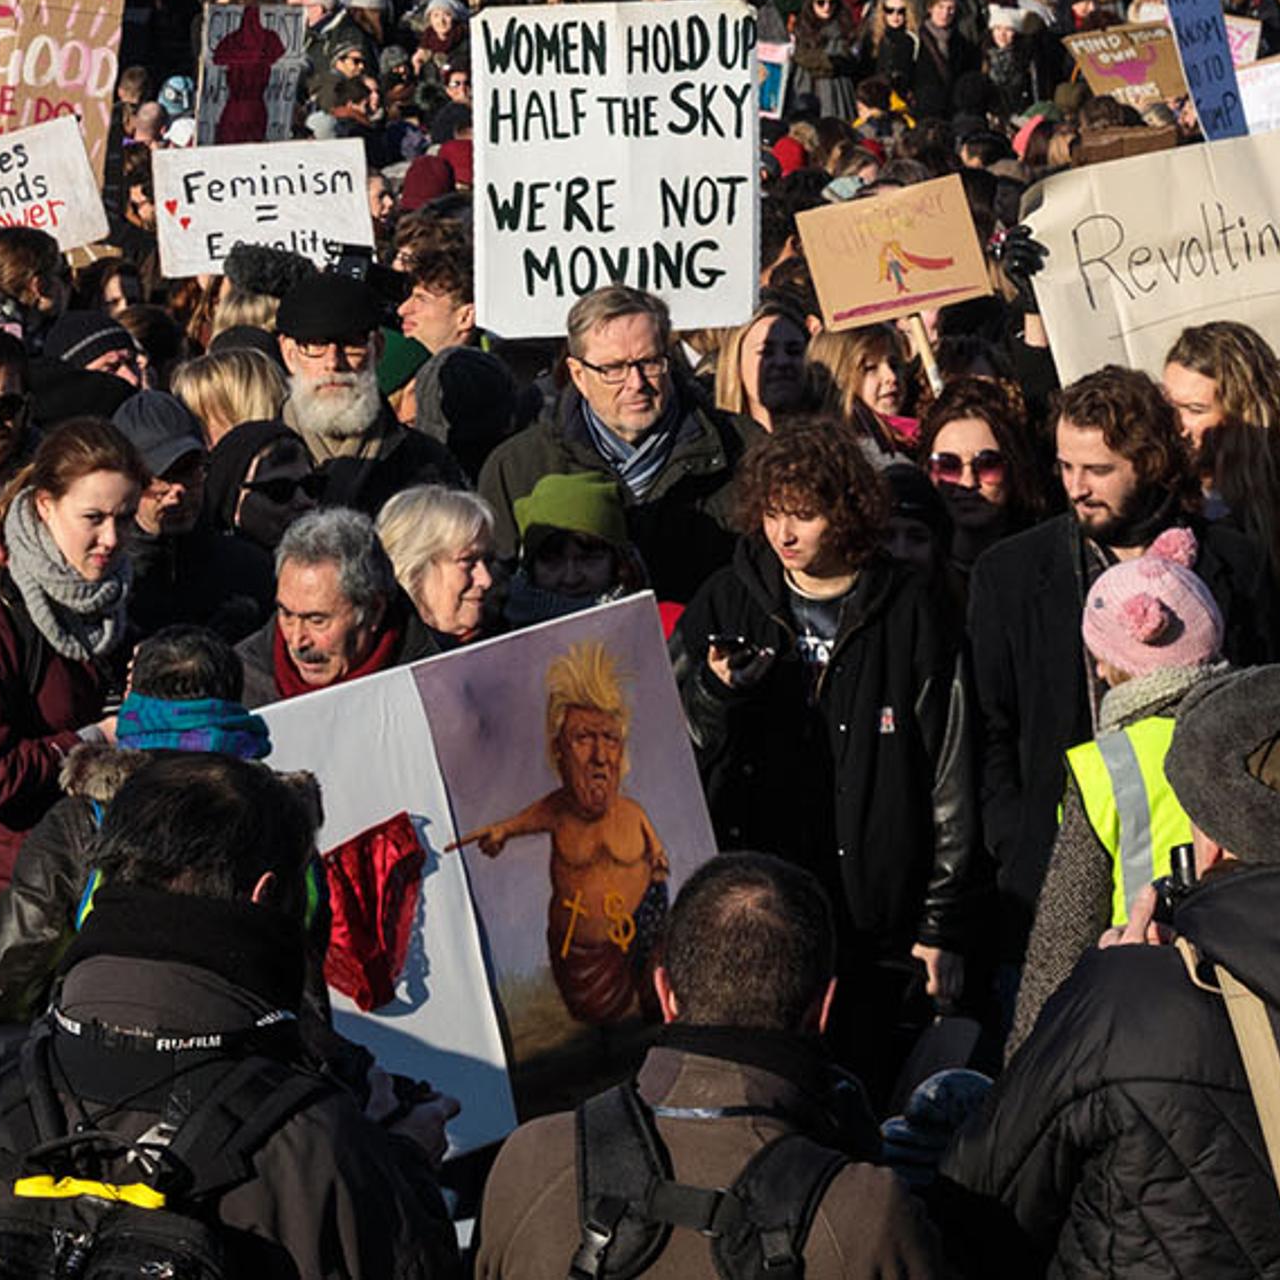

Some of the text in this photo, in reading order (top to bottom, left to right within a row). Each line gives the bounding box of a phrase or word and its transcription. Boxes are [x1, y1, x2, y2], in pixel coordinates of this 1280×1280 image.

[481, 13, 758, 76] WOMEN HOLD UP
[1070, 32, 1122, 55] MIND
[1098, 47, 1137, 65] OWN
[34, 96, 77, 125] DO
[488, 81, 753, 144] HALF THE SKY
[182, 163, 354, 205] Feminism
[487, 175, 749, 233] WE'RE NOT
[522, 240, 727, 297] MOVING
